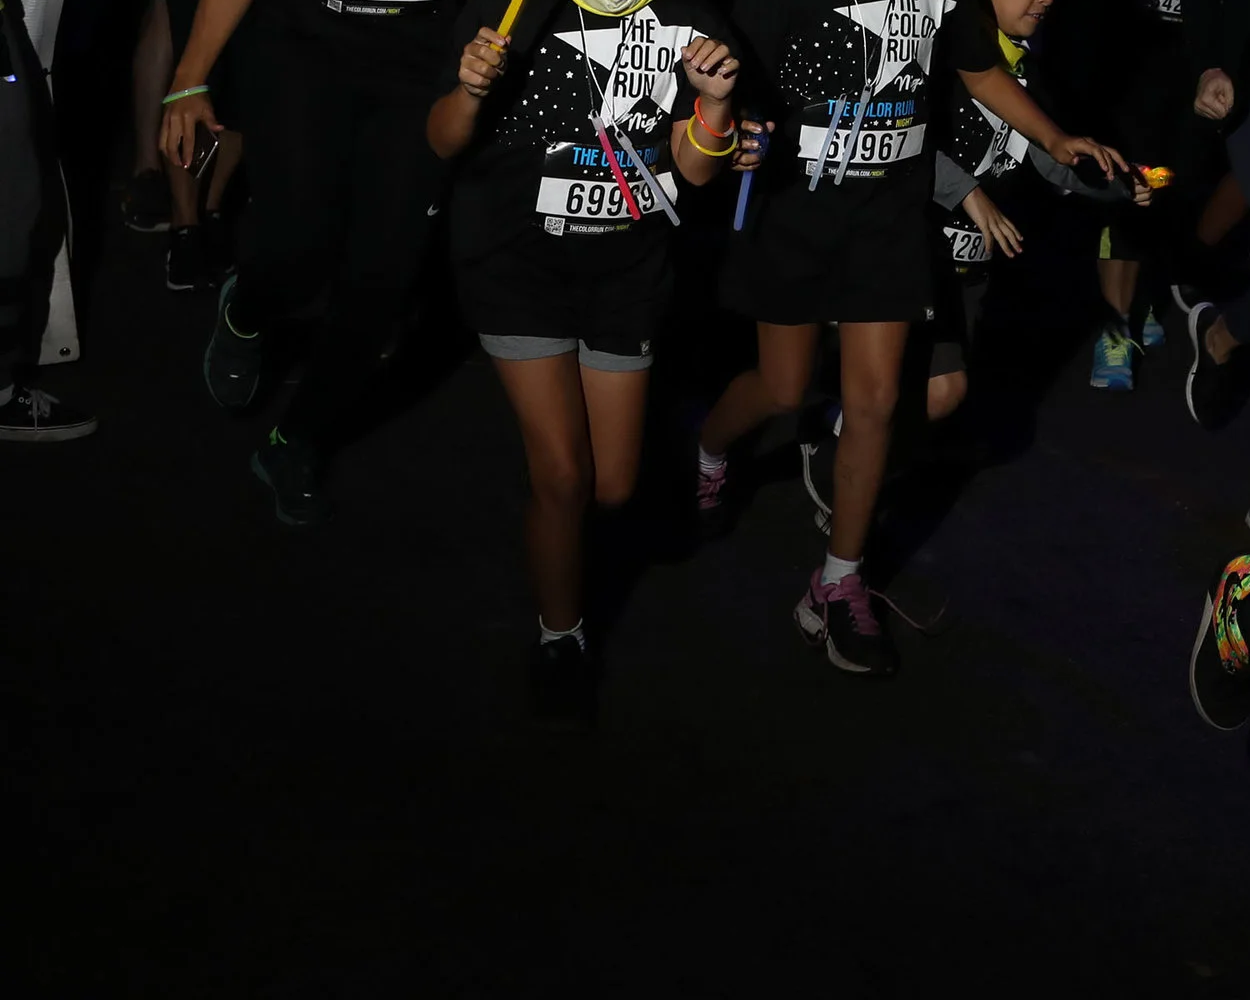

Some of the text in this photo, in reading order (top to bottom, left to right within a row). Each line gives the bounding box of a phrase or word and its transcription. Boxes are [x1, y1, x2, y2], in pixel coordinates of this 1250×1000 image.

[621, 17, 655, 43] THE
[614, 72, 655, 97] RUN
[827, 98, 852, 117] TE
[572, 146, 600, 166] THE
